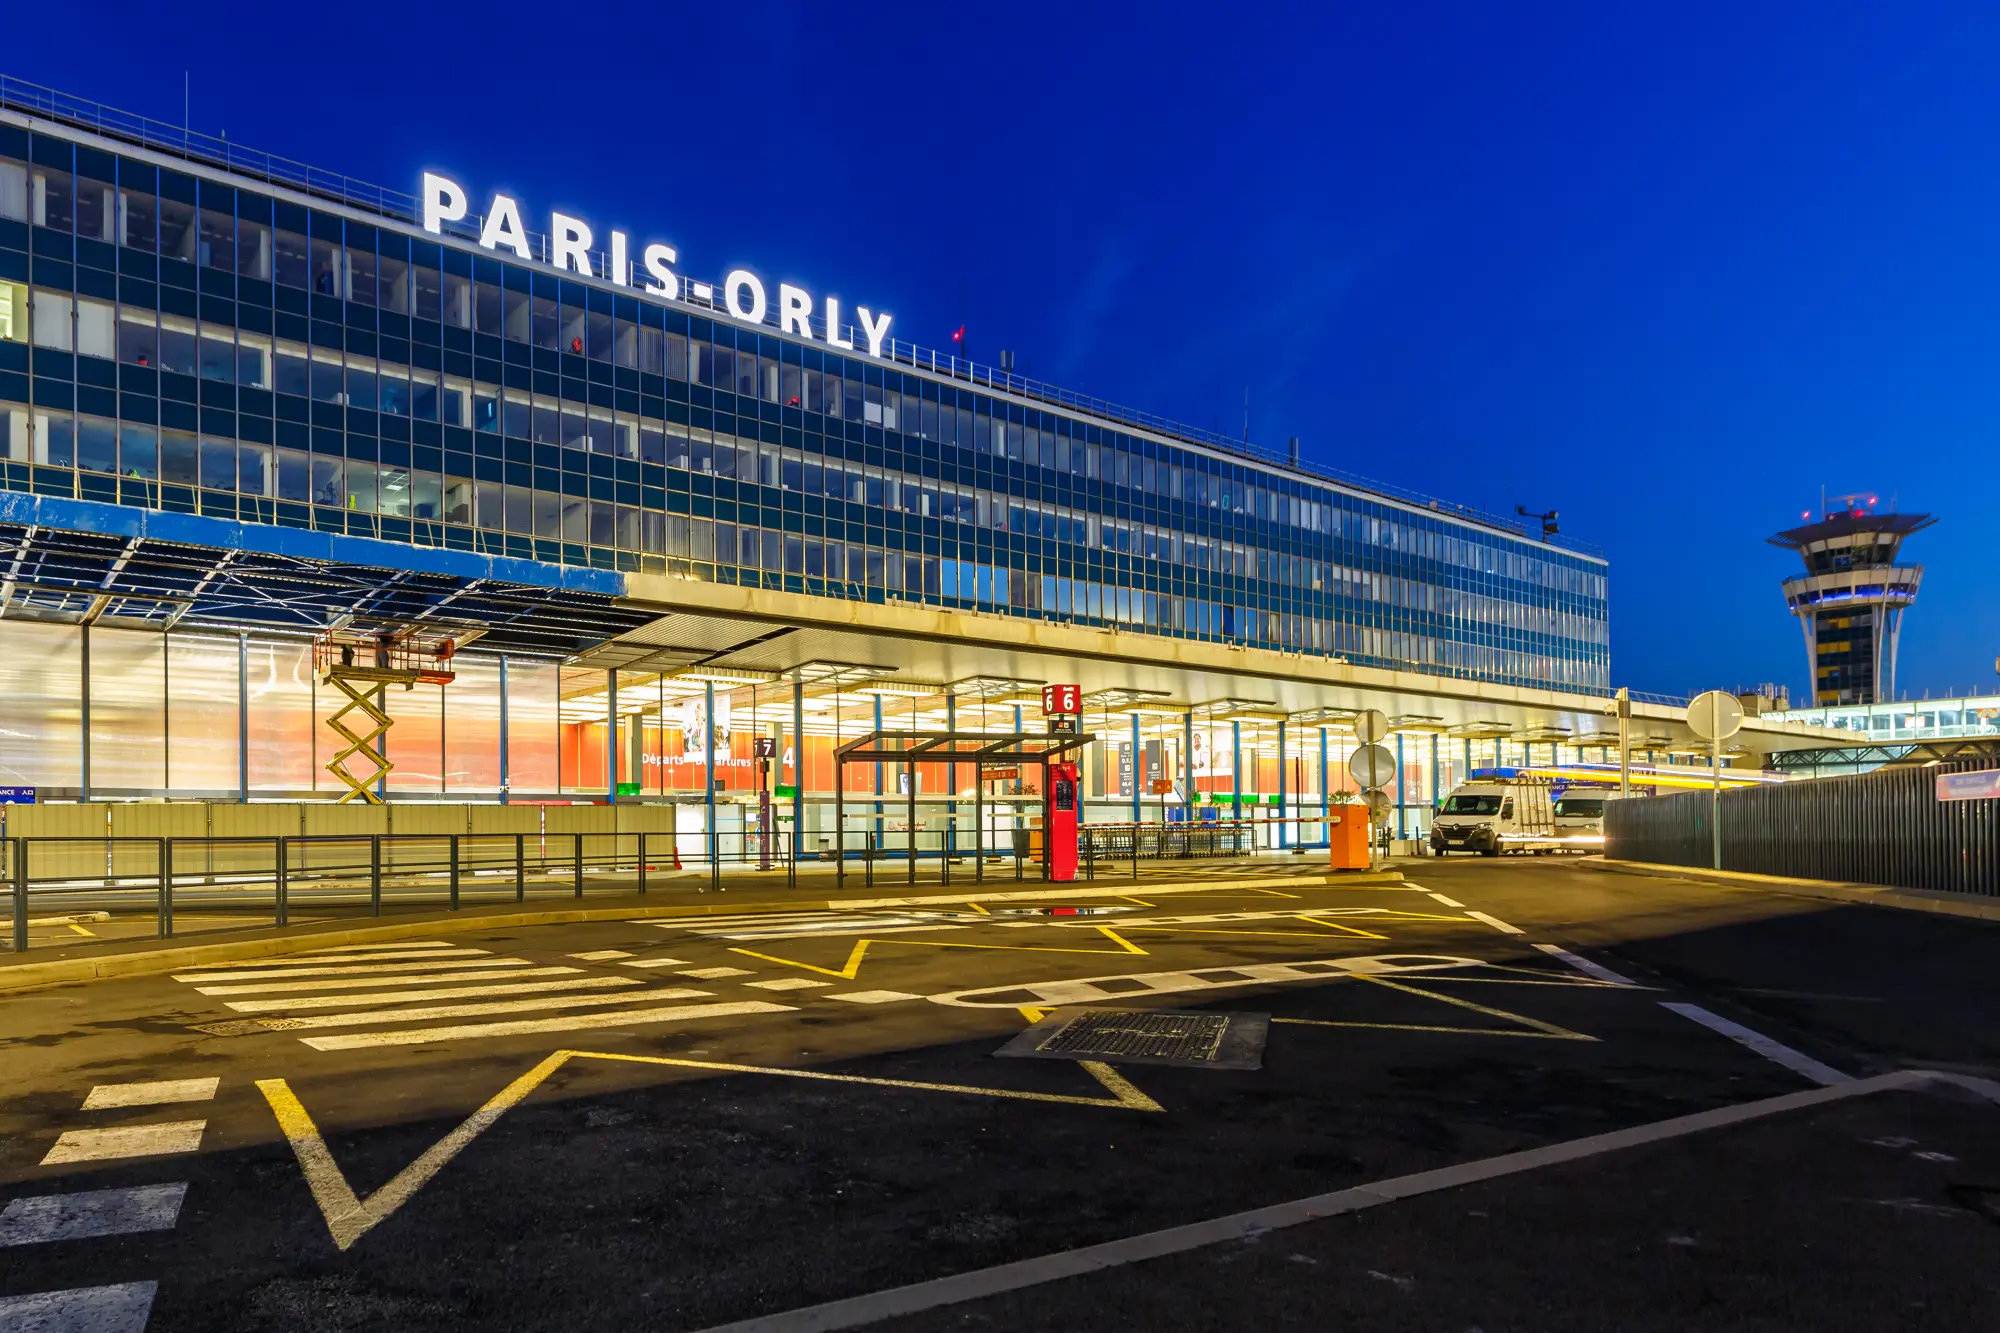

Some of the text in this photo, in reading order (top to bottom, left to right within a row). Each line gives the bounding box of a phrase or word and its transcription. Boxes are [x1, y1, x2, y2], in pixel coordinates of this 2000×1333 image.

[424, 172, 892, 358] PARIS-ORLY
[1046, 694, 1053, 711] 6
[1063, 693, 1074, 710] 6
[763, 743, 771, 756] 7
[782, 747, 795, 768] 4
[642, 753, 684, 766] Départs
